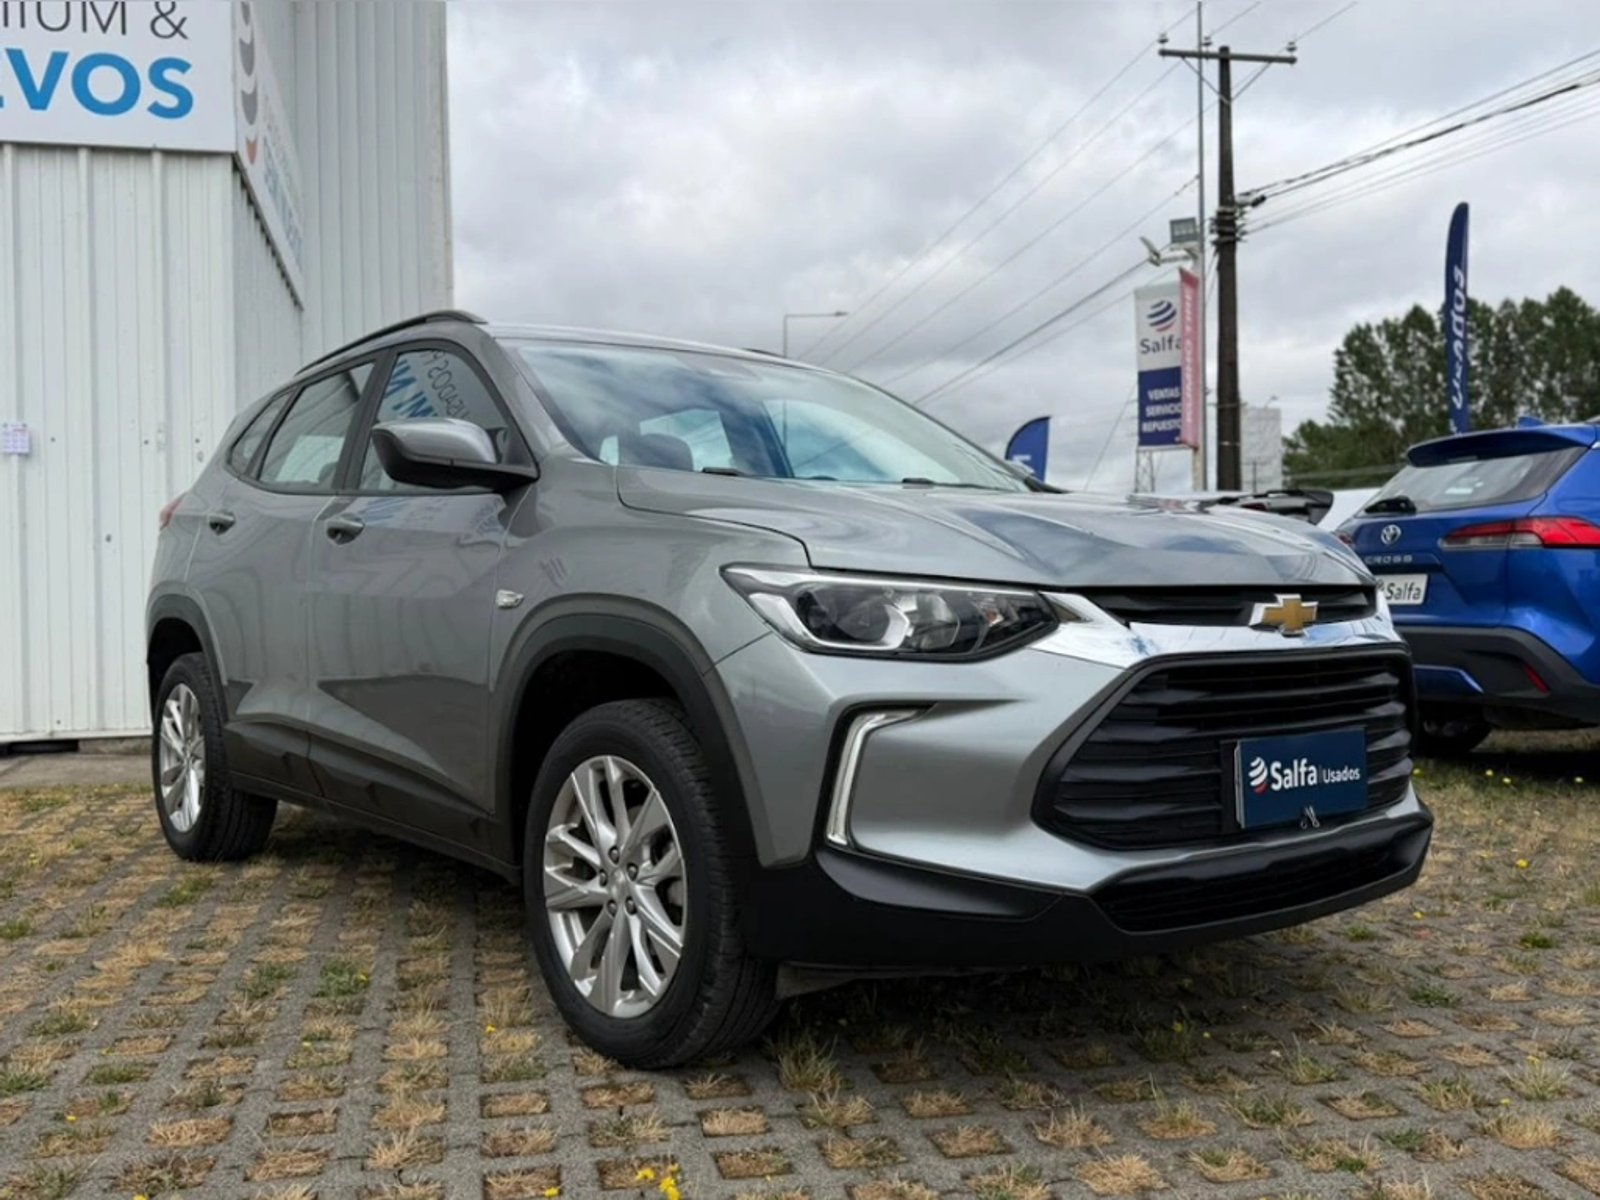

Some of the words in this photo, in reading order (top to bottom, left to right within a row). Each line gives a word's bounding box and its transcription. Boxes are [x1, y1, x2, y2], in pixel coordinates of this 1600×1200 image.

[2, 1, 127, 35] IUM
[150, 1, 189, 40] &
[0, 48, 194, 120] VOS
[1147, 387, 1181, 400] VENTAS
[1386, 582, 1421, 600] Salfa
[1270, 757, 1318, 791] Salfa
[1323, 765, 1361, 782] Usados
